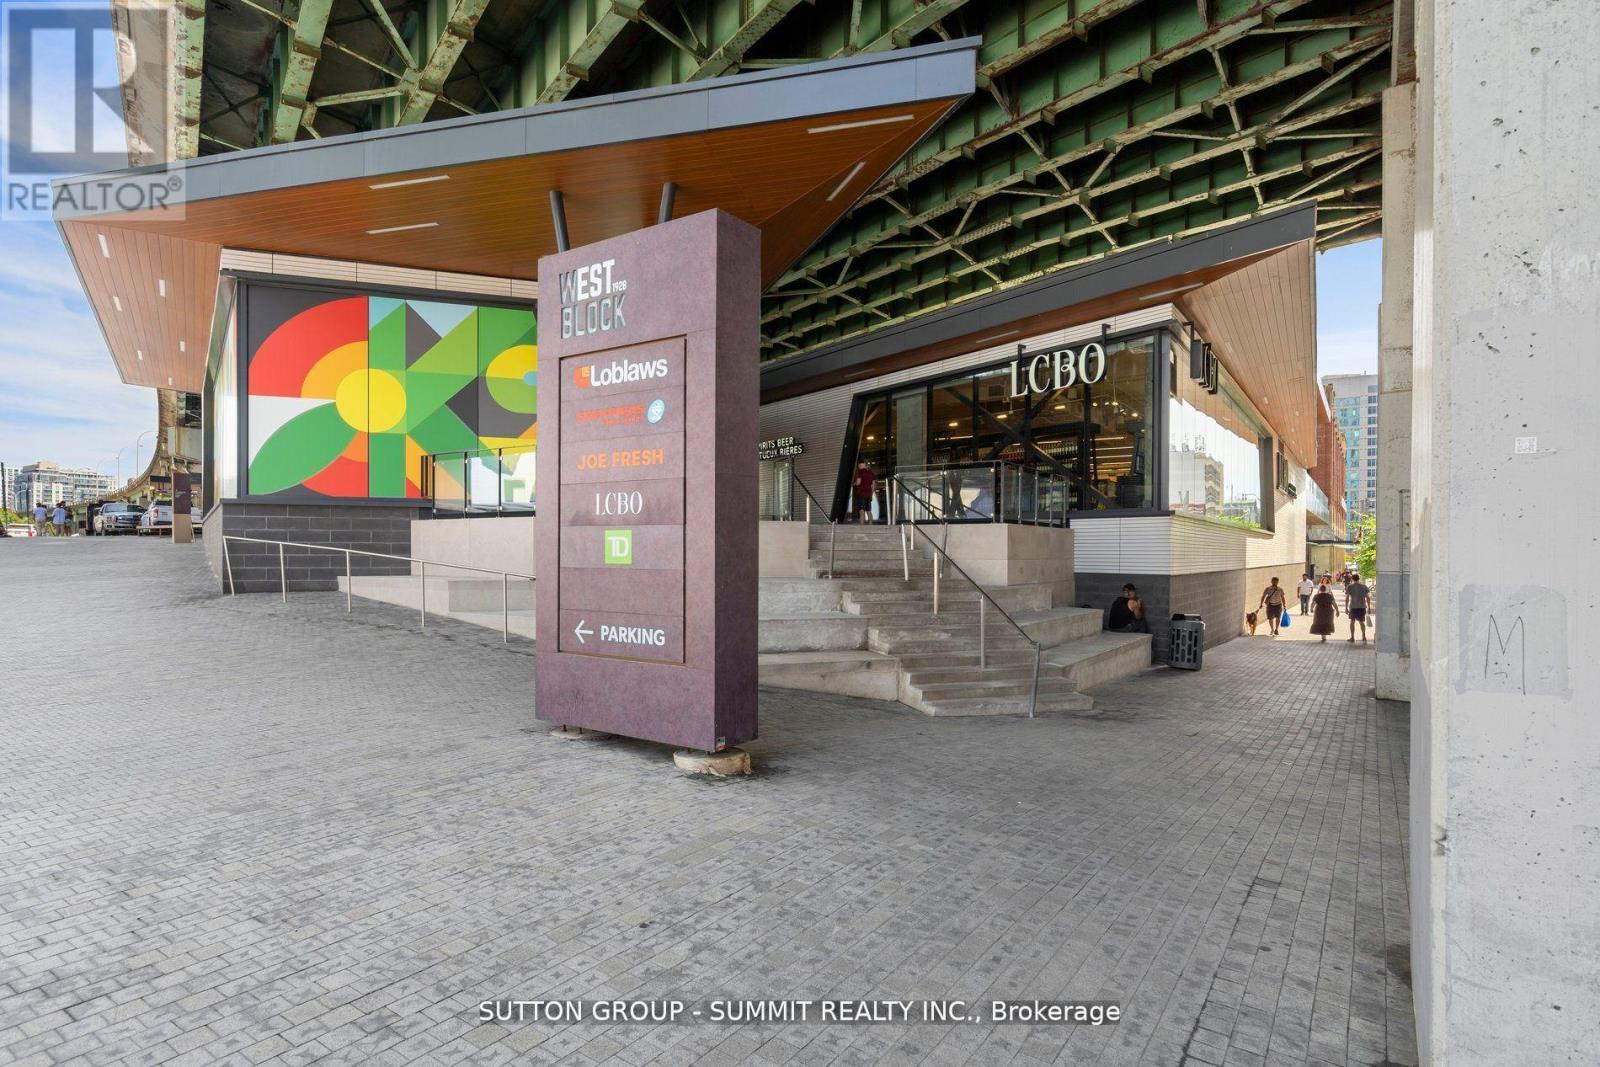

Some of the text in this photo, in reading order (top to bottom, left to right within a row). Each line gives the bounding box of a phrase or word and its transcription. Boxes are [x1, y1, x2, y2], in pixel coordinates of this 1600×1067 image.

[559, 259, 615, 304] WEST
[560, 293, 627, 339] BLOCK
[590, 358, 669, 388] Loblaws
[1010, 342, 1107, 398] LCBO
[777, 437, 793, 447] BEER
[577, 448, 666, 470] JOE FRESH
[595, 491, 643, 515] LCBO
[608, 536, 629, 557] TD
[600, 625, 666, 646] PARKING
